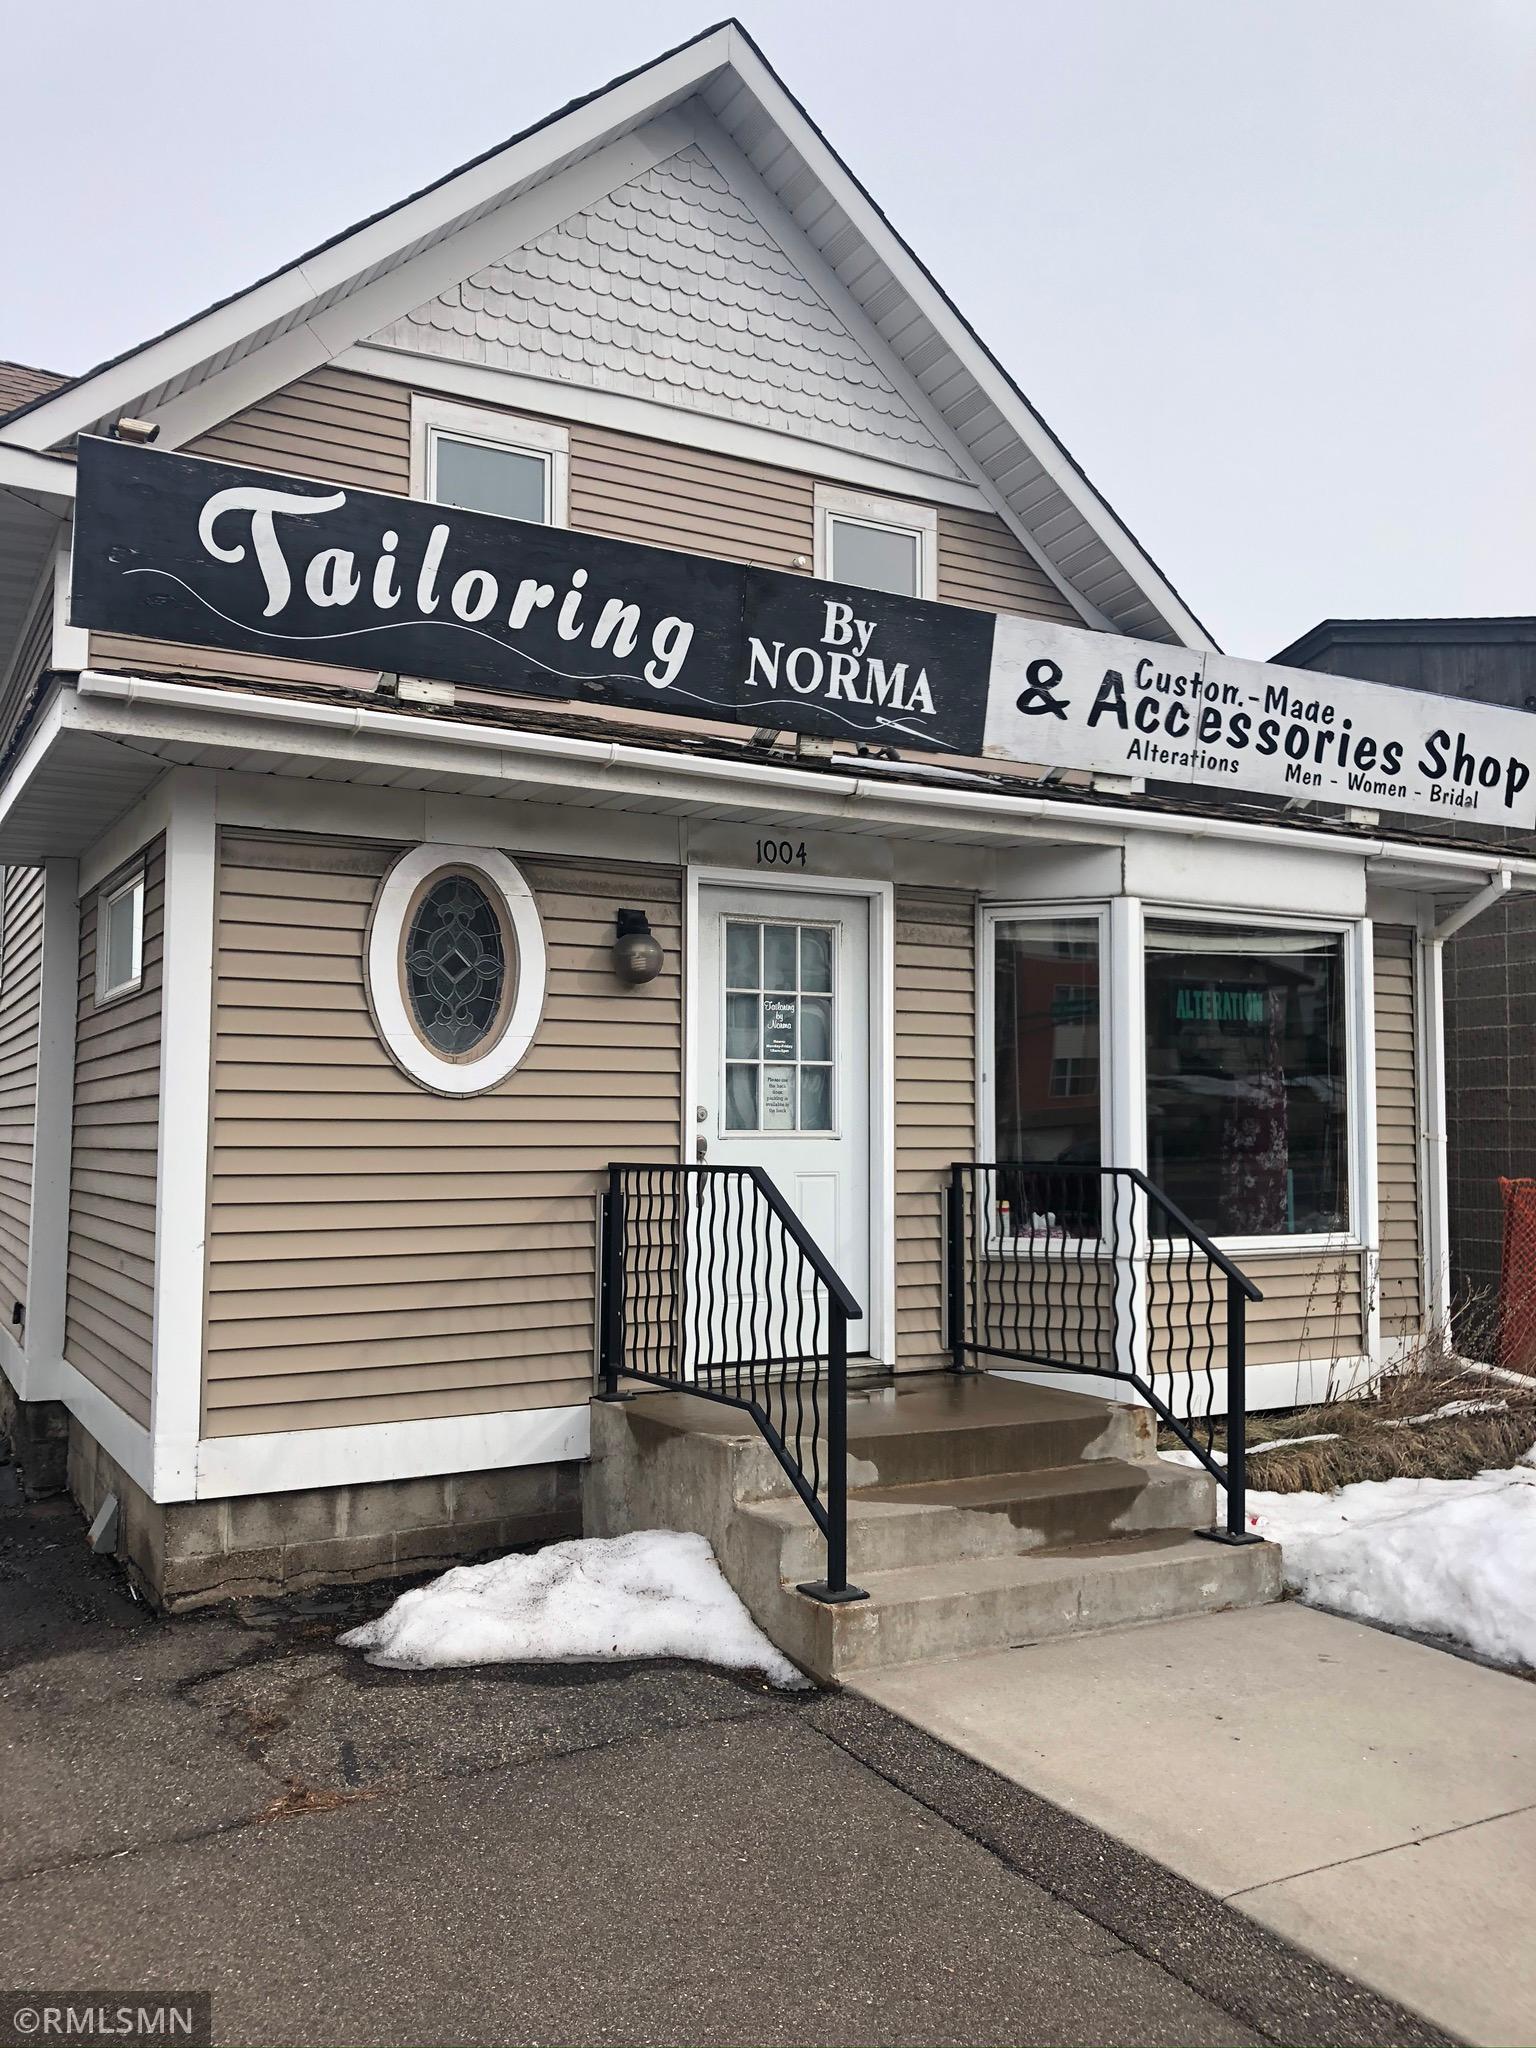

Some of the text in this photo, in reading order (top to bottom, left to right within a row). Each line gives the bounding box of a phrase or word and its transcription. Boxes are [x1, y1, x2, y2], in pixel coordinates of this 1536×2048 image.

[198, 486, 695, 689] Tailoring
[820, 600, 877, 657] By
[744, 637, 937, 715] NORMA
[1016, 658, 1530, 809] & Accessories Shop
[1126, 738, 1240, 774] Alterations
[1285, 763, 1322, 787] Men
[1348, 772, 1407, 798] Women
[1430, 784, 1479, 809] Bridal
[756, 839, 807, 867] 1004
[764, 1000, 795, 1013] Tailoring
[767, 1019, 792, 1029] Norma
[775, 1011, 784, 1021] by
